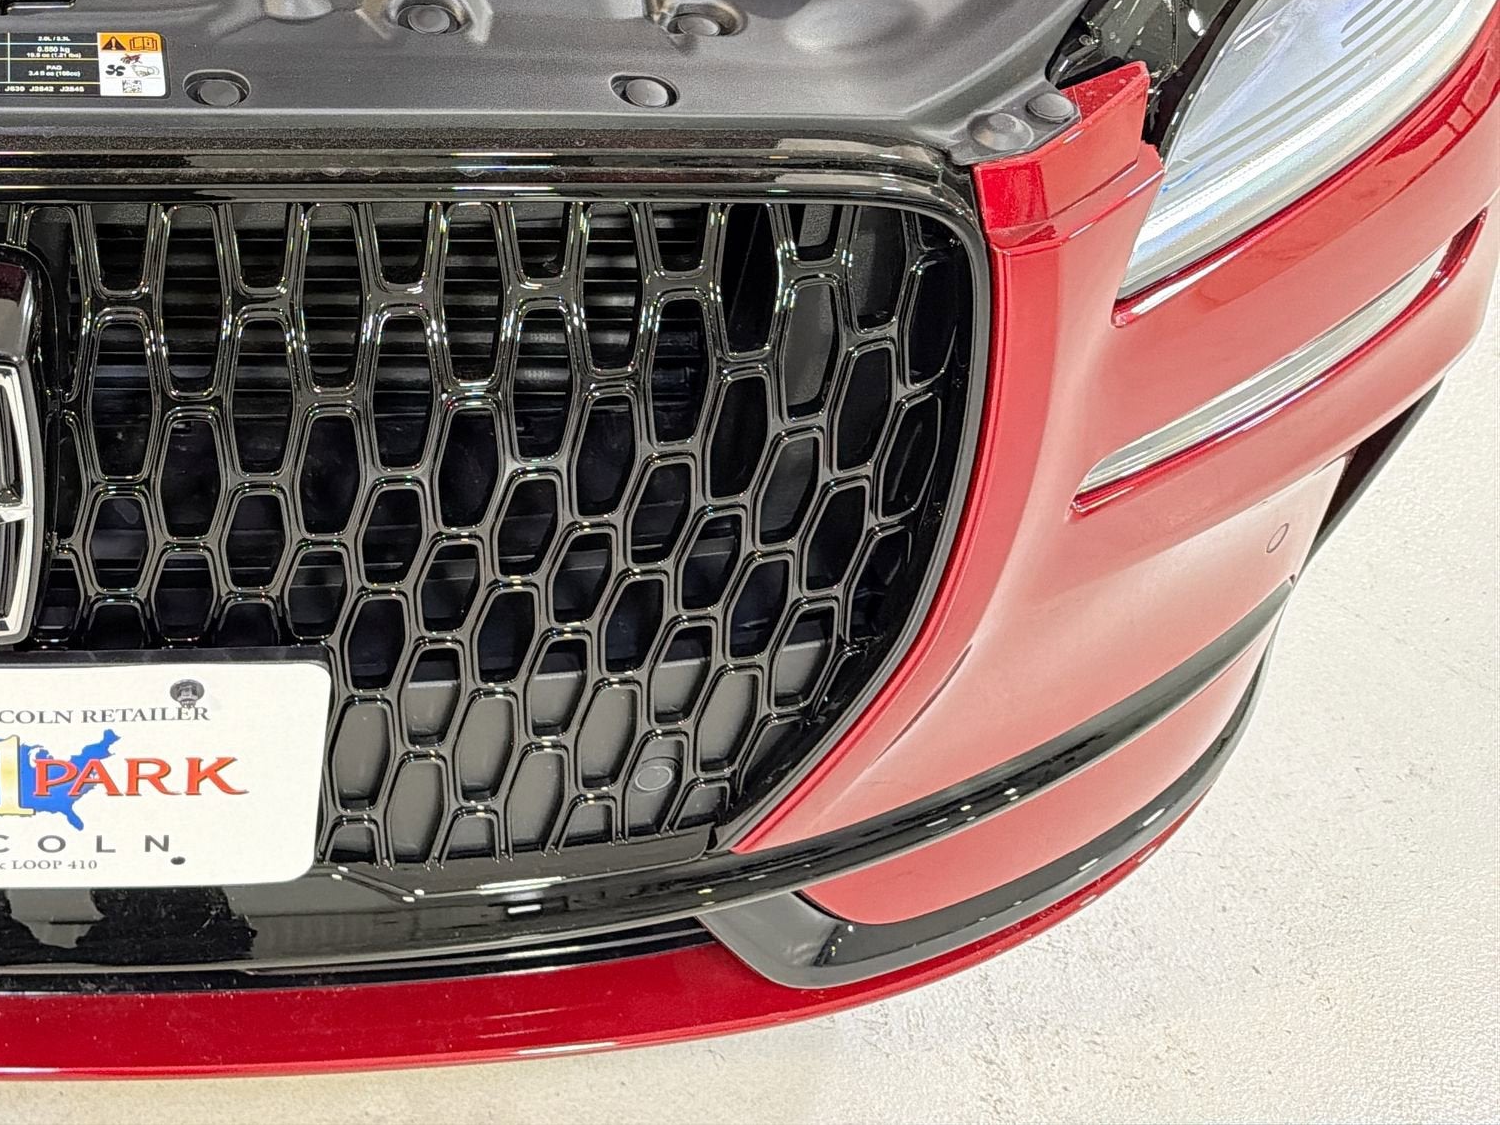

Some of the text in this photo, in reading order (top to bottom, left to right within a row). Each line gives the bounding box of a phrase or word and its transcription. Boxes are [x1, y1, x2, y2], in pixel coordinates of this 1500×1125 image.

[59, 46, 71, 54] kg
[82, 707, 210, 723] RETAILER
[33, 756, 250, 797] PARK
[12, 859, 63, 870] LOOP
[67, 859, 98, 870] 410
